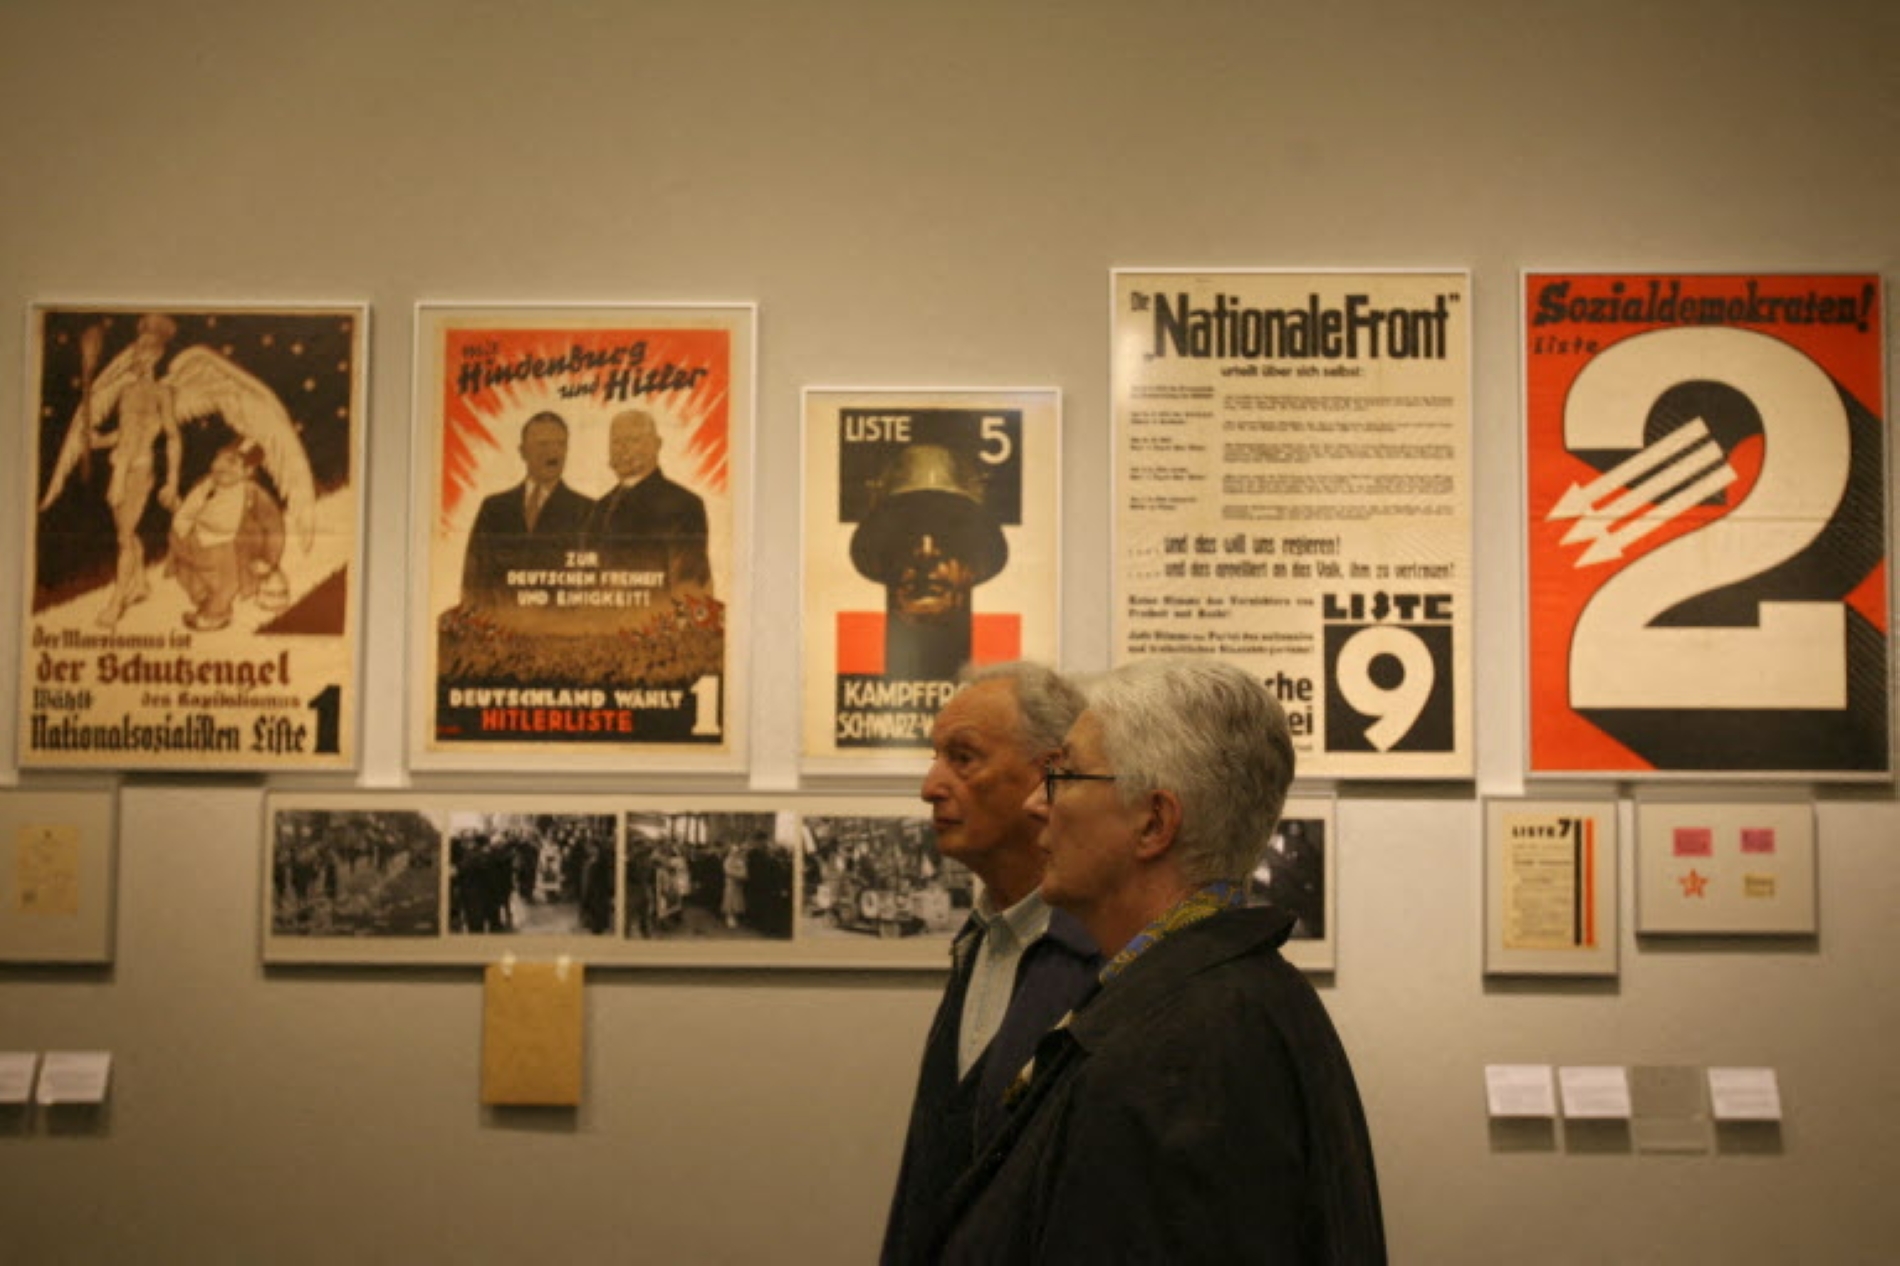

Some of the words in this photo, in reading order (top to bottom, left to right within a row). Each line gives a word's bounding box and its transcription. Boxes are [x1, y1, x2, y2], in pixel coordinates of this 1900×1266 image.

[1534, 281, 1875, 333] Sozialdemokraten!
[458, 340, 648, 395] Hindenburg
[557, 375, 601, 399] und
[603, 362, 708, 401] Hitler
[1297, 364, 1320, 377] sich
[845, 415, 912, 442] LISTE
[978, 415, 1012, 465] 5
[1564, 326, 1852, 710] 2
[565, 552, 597, 567] ZUR
[518, 590, 549, 606] UND
[1322, 591, 1453, 620] LISTE
[37, 652, 85, 684] der
[97, 650, 290, 692] Schutzengel
[1336, 626, 1435, 753] 9
[450, 688, 606, 708] DEUTSCHLAND
[691, 675, 721, 735] 1
[31, 714, 239, 753] Nationalsozialisten
[307, 683, 341, 755] 1
[481, 709, 633, 732] HITLERLISTE
[1557, 818, 1571, 838] 7
